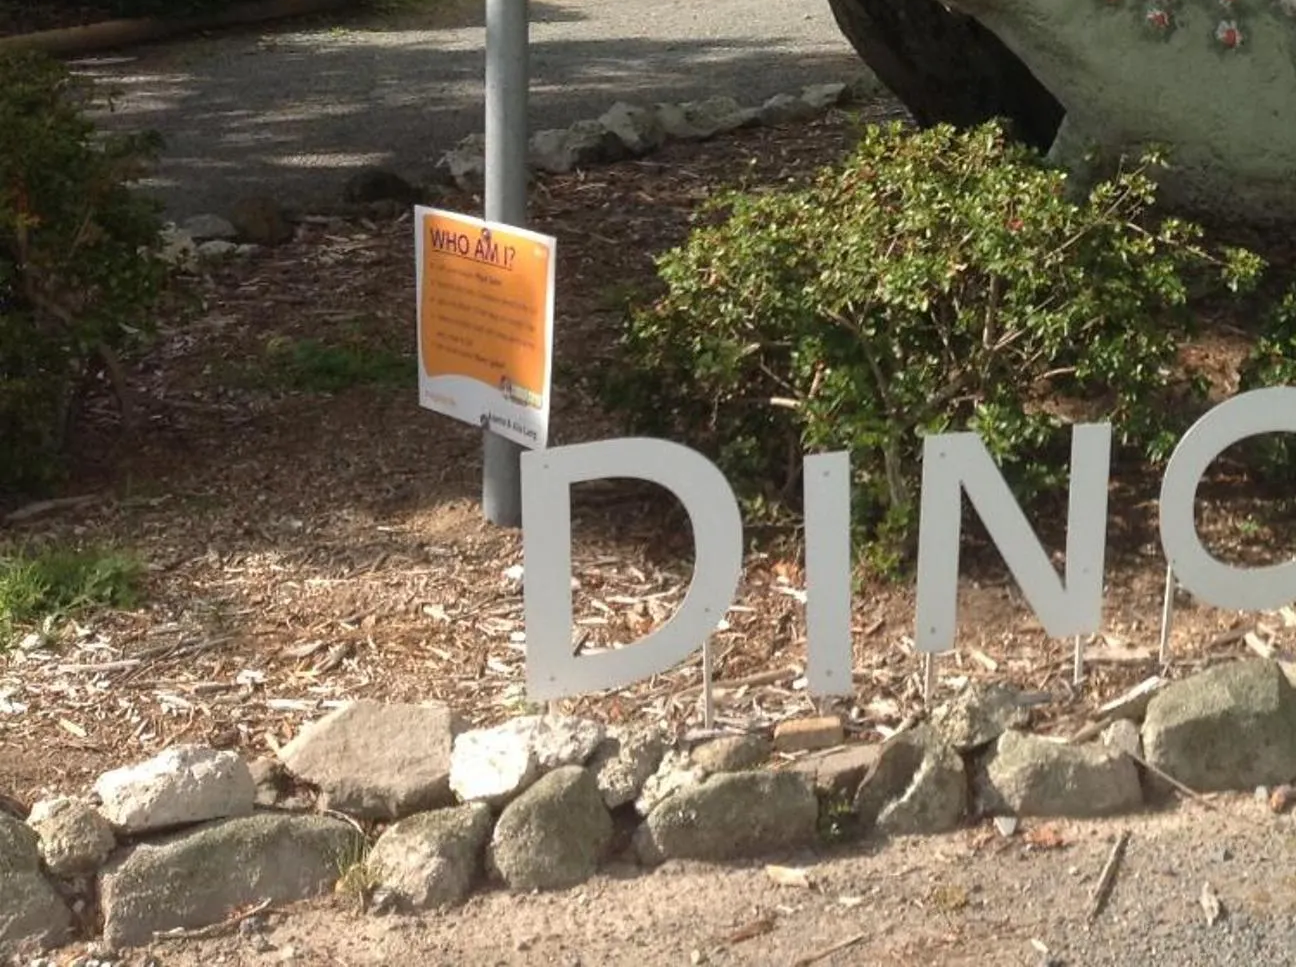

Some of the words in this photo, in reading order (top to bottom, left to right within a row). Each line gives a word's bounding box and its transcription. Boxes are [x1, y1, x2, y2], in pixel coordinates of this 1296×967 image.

[431, 226, 470, 255] WHO
[475, 238, 499, 263] AM
[503, 244, 516, 268] I?
